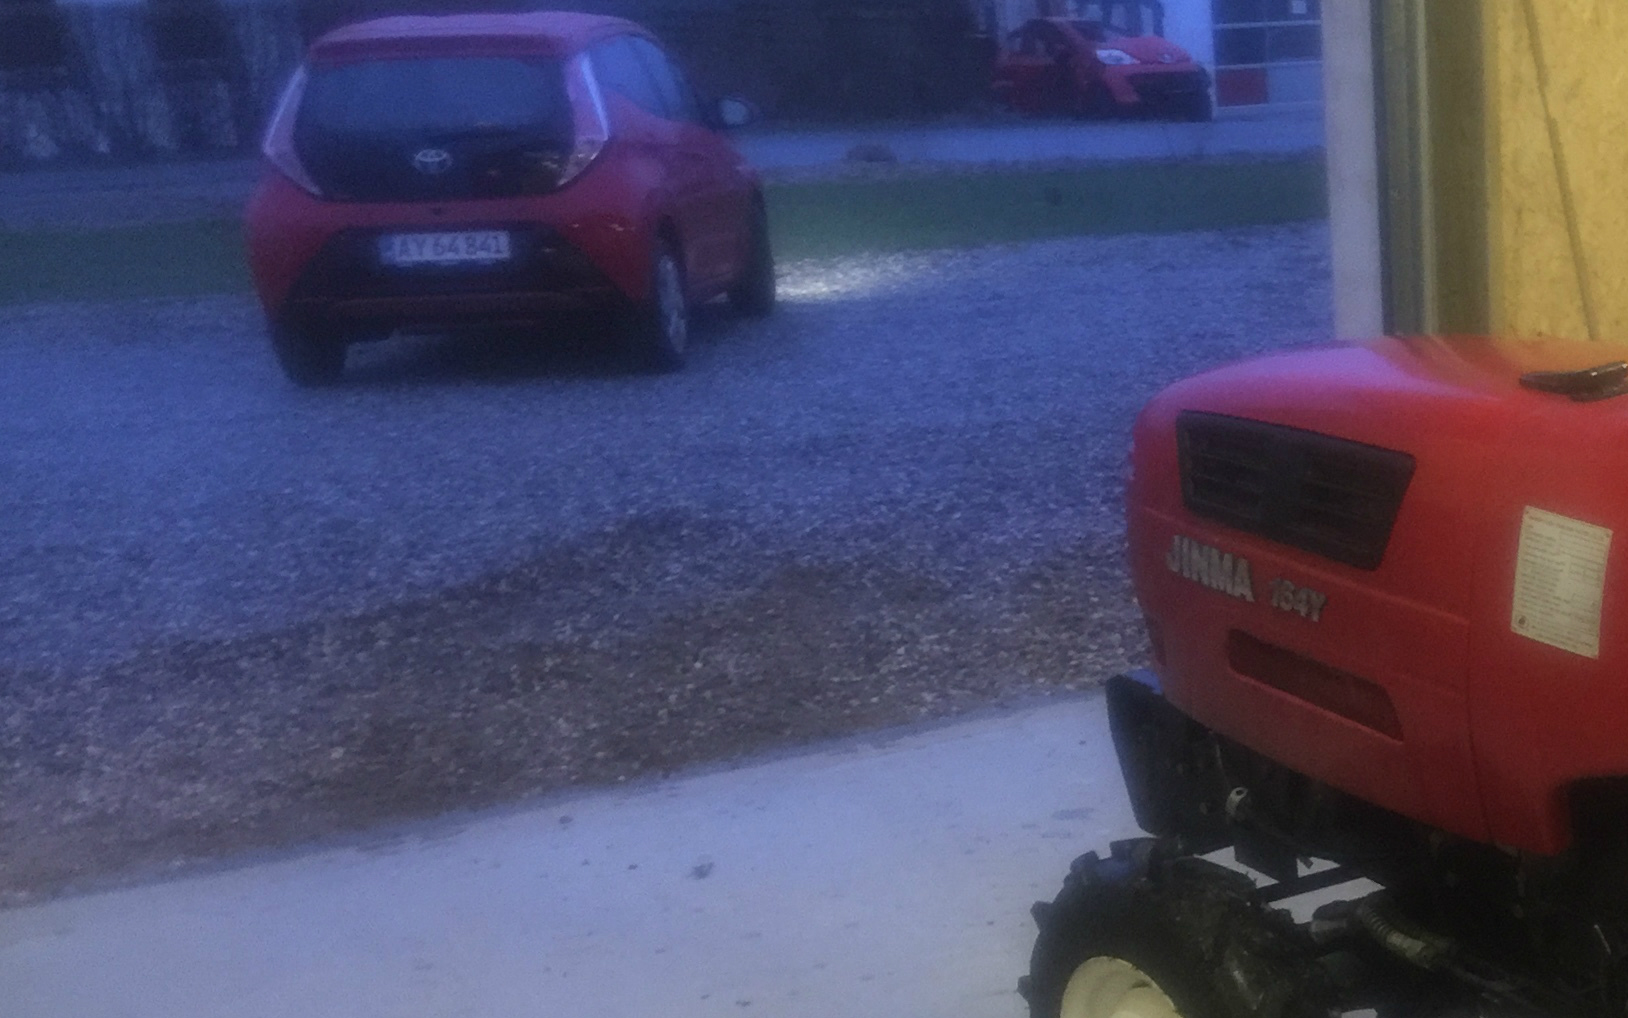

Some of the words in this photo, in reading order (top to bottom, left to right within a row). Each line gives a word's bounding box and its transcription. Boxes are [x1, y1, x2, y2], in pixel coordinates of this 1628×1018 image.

[397, 237, 427, 258] AY
[432, 236, 460, 257] 64
[465, 235, 504, 256] 841
[1166, 534, 1255, 603] JINMA
[1269, 577, 1328, 623] 164Y
